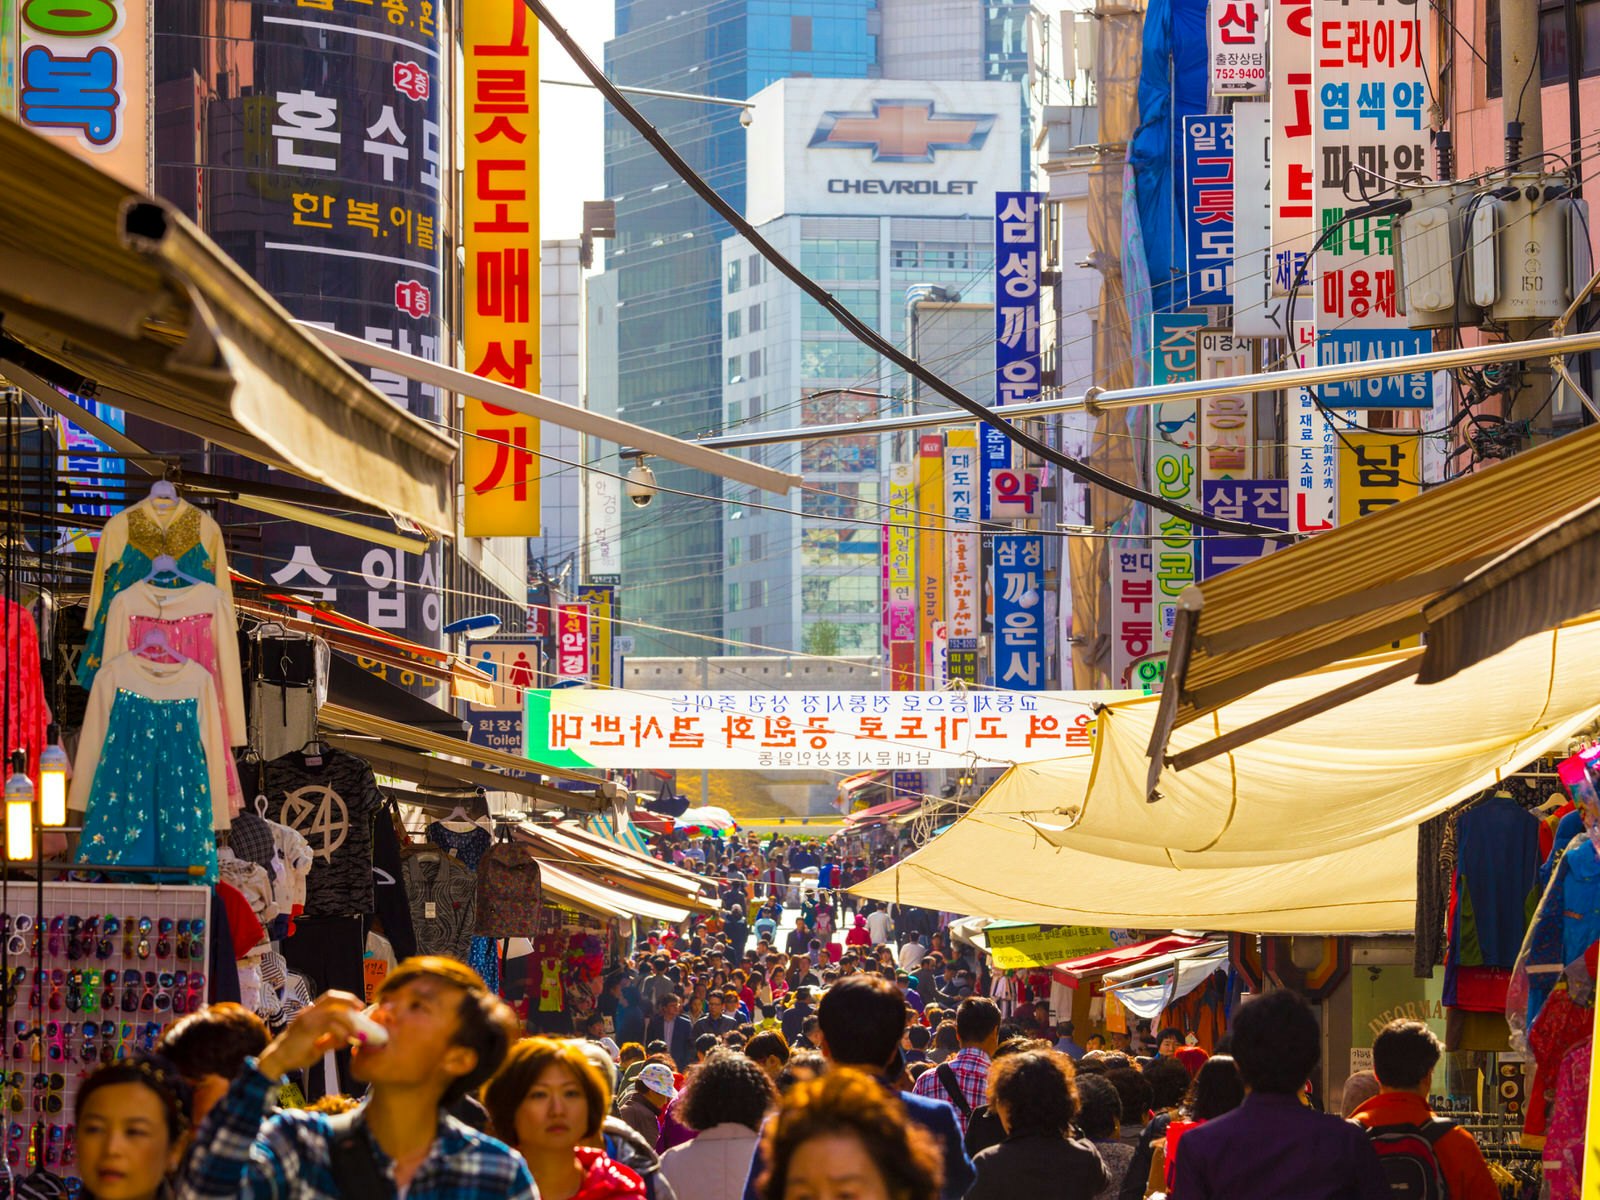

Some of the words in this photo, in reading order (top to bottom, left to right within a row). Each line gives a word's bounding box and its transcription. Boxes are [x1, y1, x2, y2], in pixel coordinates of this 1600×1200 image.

[1216, 52, 1263, 66] 출장상담
[1320, 19, 1421, 68] 드라이기
[1320, 81, 1424, 131] 염색약
[827, 178, 977, 195] CHEVROLET
[999, 196, 1041, 406] 삼성까운
[1323, 269, 1402, 318] 미용재
[1300, 448, 1313, 489] 도소매
[995, 472, 1040, 514] 약
[997, 541, 1041, 567] 삼성
[925, 576, 937, 616] Alpha
[1001, 572, 1041, 686] 까운사
[562, 633, 586, 673] 안경
[486, 734, 521, 746] Toilet
[1368, 1000, 1447, 1037] INFORMA
